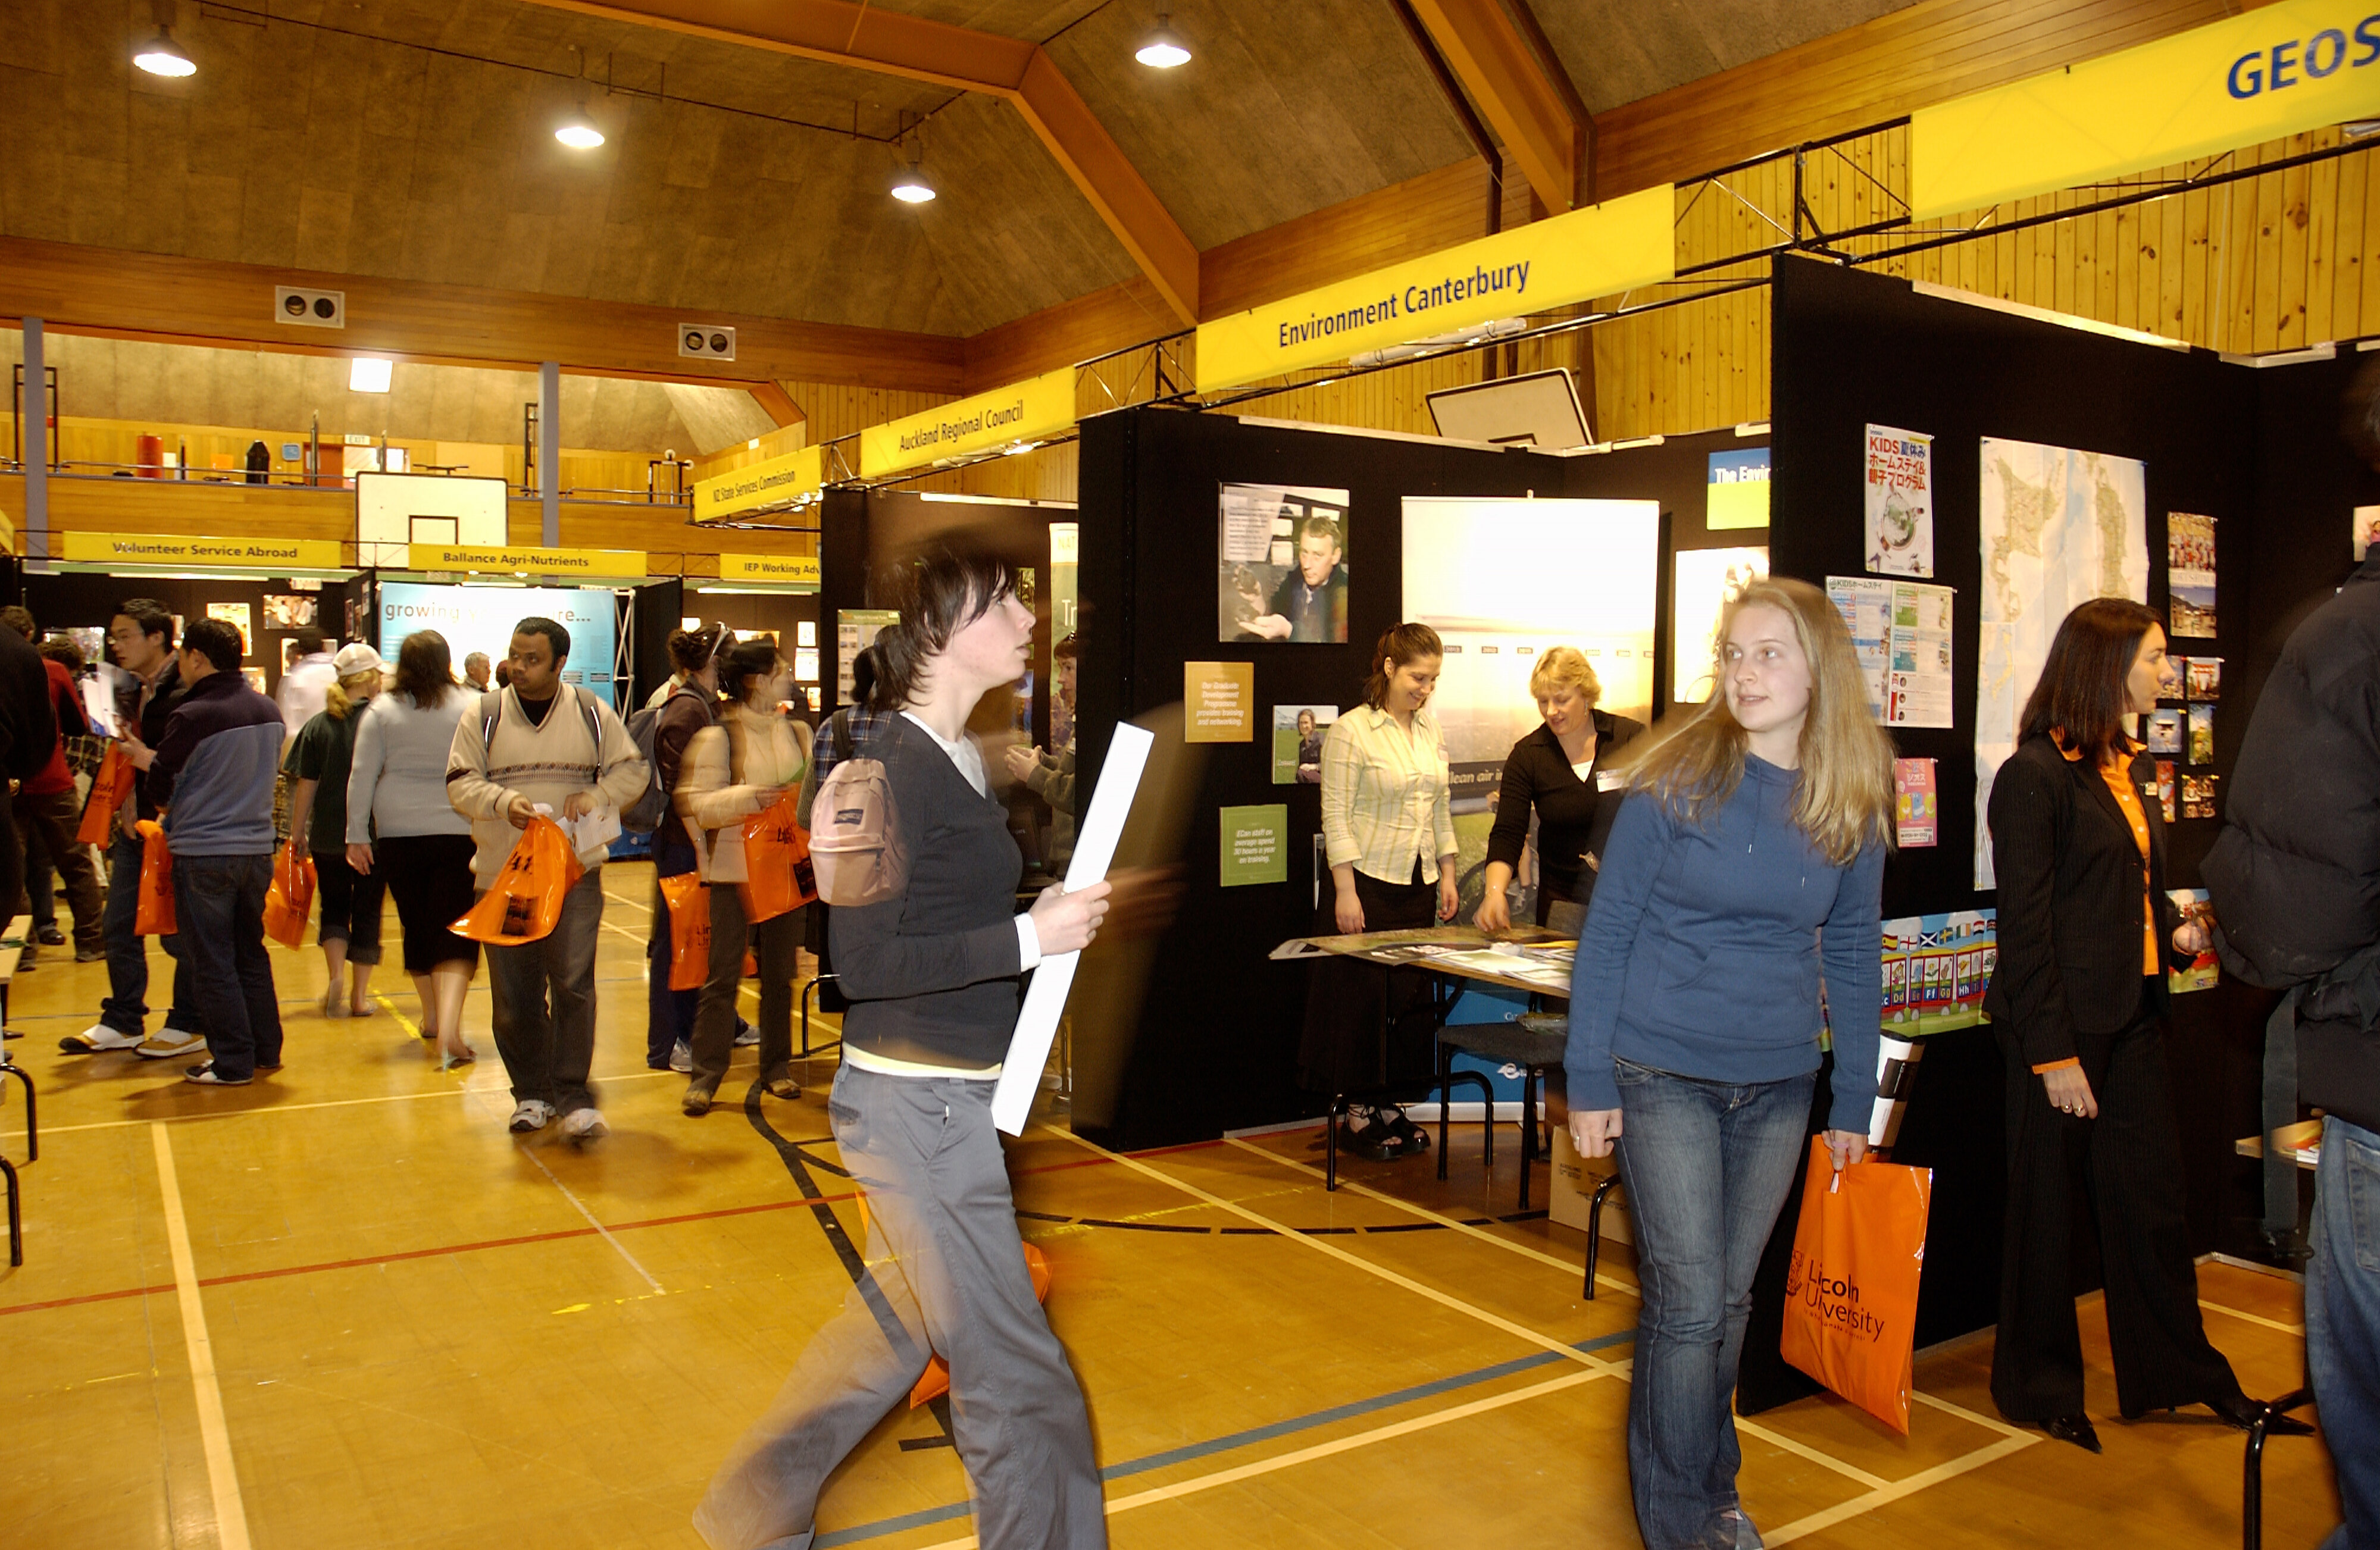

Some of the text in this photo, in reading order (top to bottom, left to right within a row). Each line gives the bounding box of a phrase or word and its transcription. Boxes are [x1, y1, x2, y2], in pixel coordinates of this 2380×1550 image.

[2228, 12, 2380, 99] GEOS
[1279, 260, 1531, 348] Environment Canterbury
[899, 399, 1024, 452] Auckland Regional Council
[1870, 436, 1900, 455] KIDS
[1715, 464, 1771, 484] The Envir
[721, 487, 734, 501] State
[736, 479, 758, 497] Services
[759, 468, 795, 490] Commission
[112, 542, 298, 559] Volunteer Service Abroad
[443, 552, 589, 568] Ballance Agri-Nutrients
[744, 562, 759, 571] IEP
[762, 563, 800, 575] Working
[386, 602, 459, 623] growing
[1449, 771, 1475, 784] lean
[1477, 769, 1494, 782] air
[1809, 1259, 1860, 1303] Licoln
